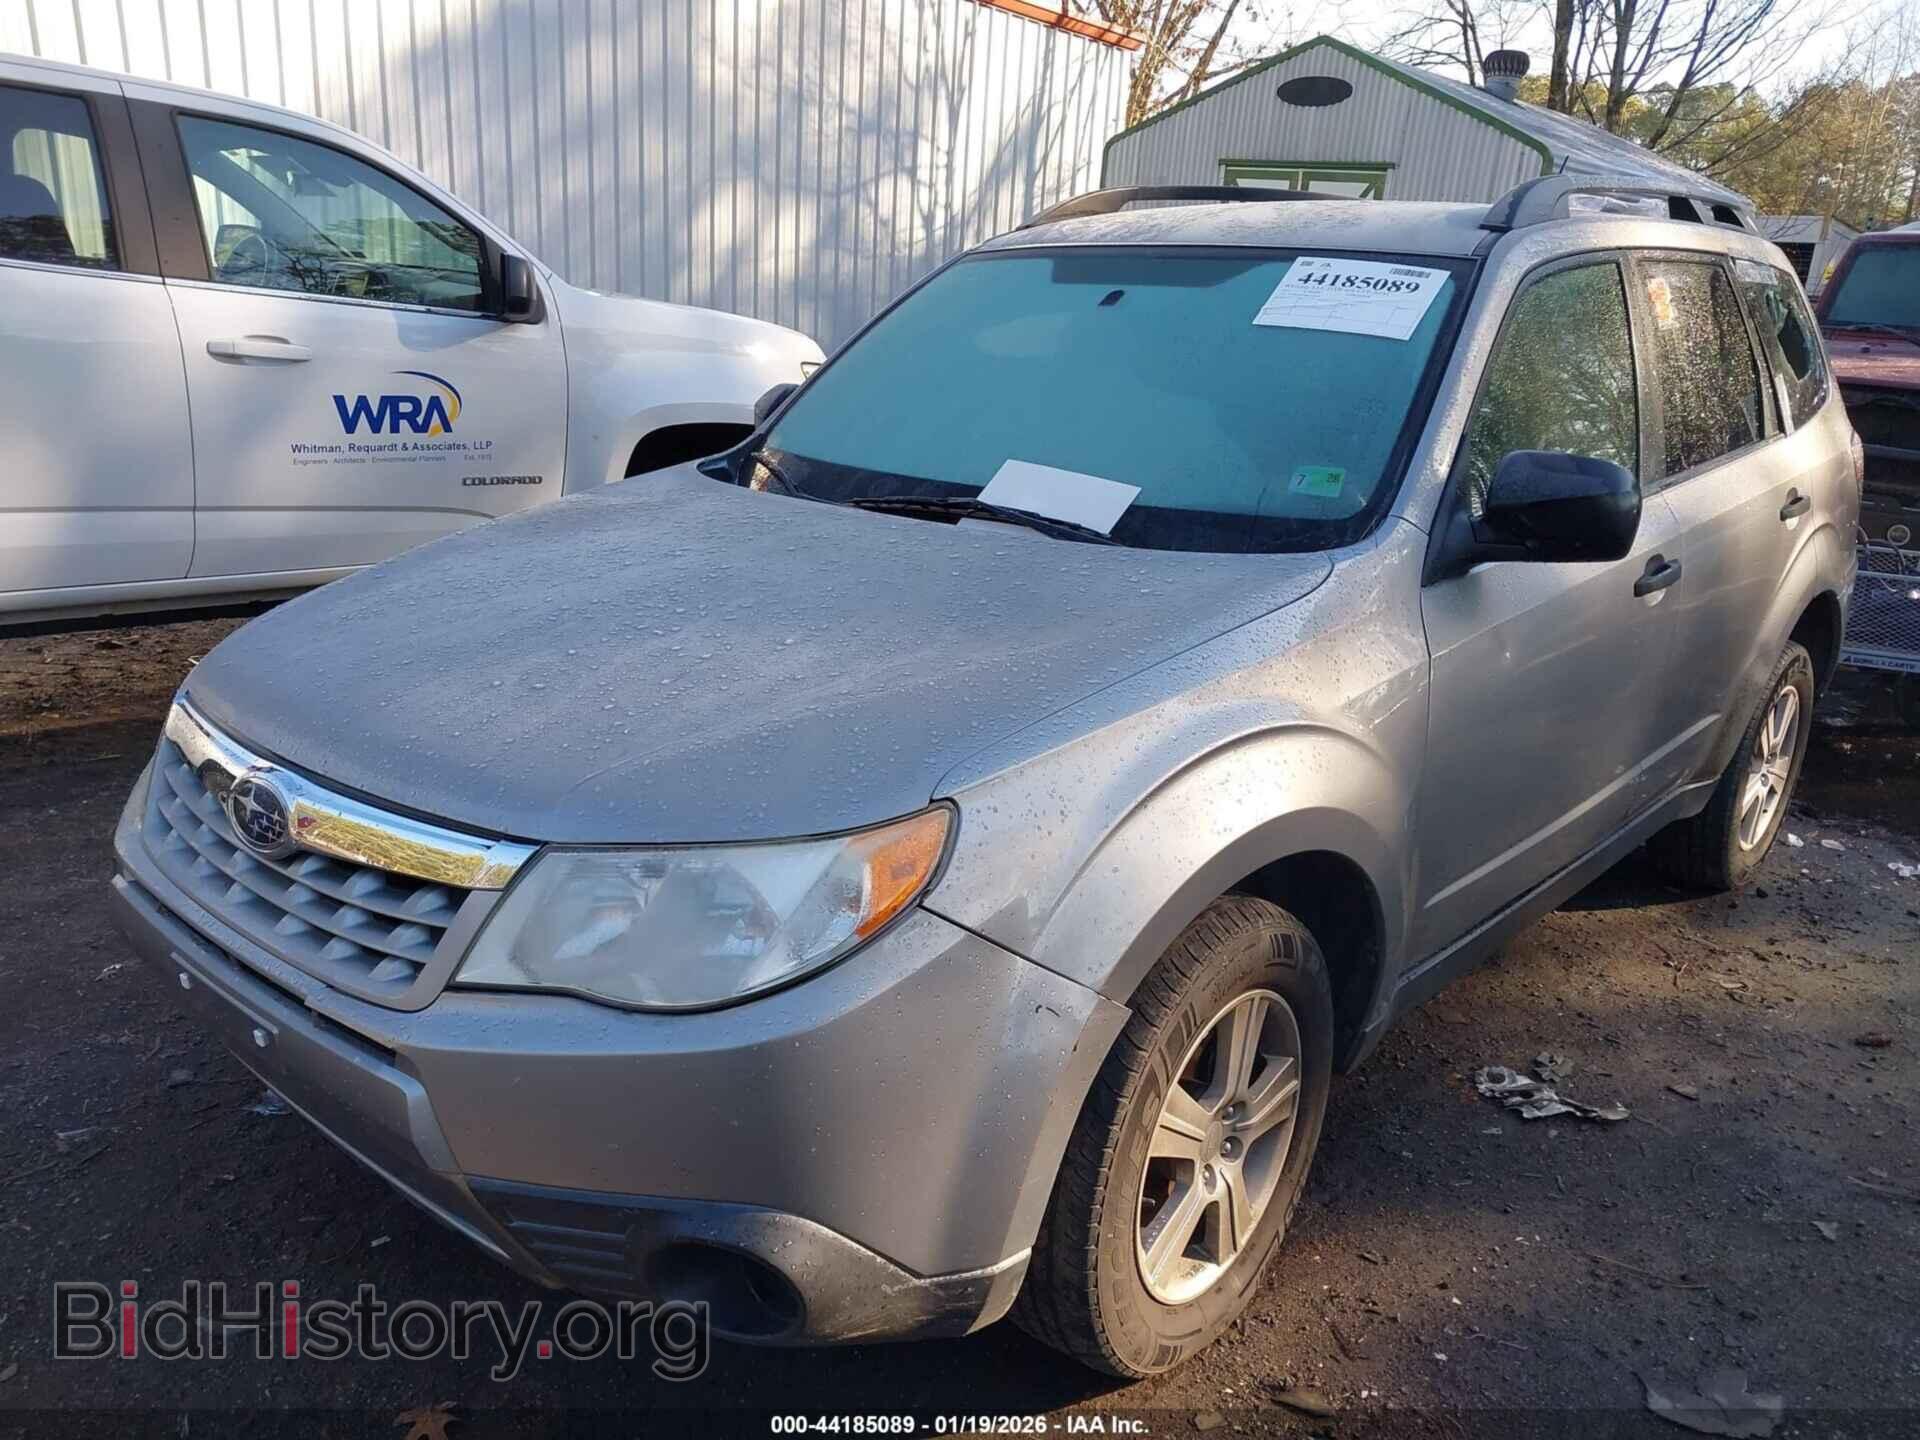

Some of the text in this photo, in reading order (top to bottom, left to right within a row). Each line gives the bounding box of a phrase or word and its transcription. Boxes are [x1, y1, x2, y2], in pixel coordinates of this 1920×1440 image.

[1298, 272, 1421, 294] 44185089
[332, 395, 453, 434] WRA
[291, 443, 345, 454] Whitman,
[348, 442, 398, 454] Requardt
[401, 442, 409, 452] &
[473, 440, 493, 450] LLP
[462, 475, 543, 487] COLORADO
[1297, 473, 1307, 486] 7
